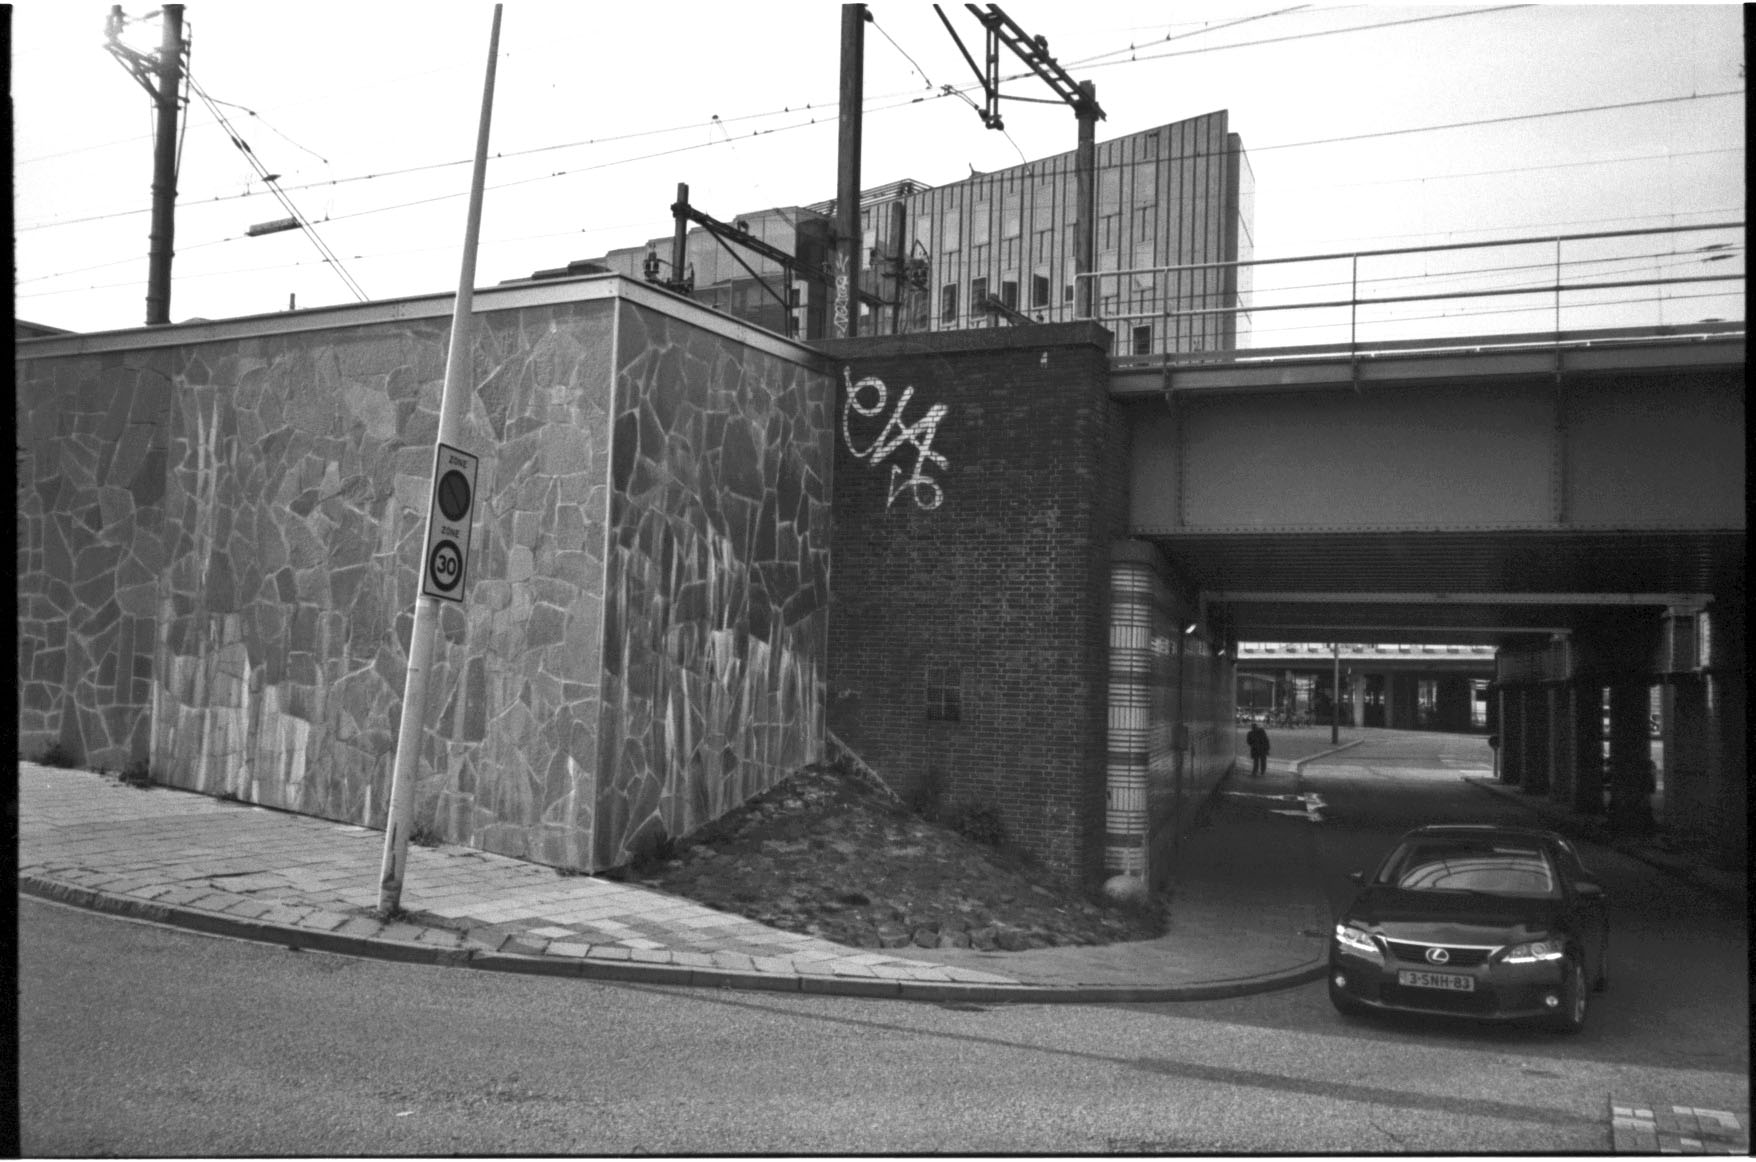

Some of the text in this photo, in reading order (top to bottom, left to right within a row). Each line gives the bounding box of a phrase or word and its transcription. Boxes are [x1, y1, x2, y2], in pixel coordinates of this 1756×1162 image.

[449, 455, 468, 469] ZONE
[441, 526, 460, 539] ZONE
[437, 555, 457, 576] 30
